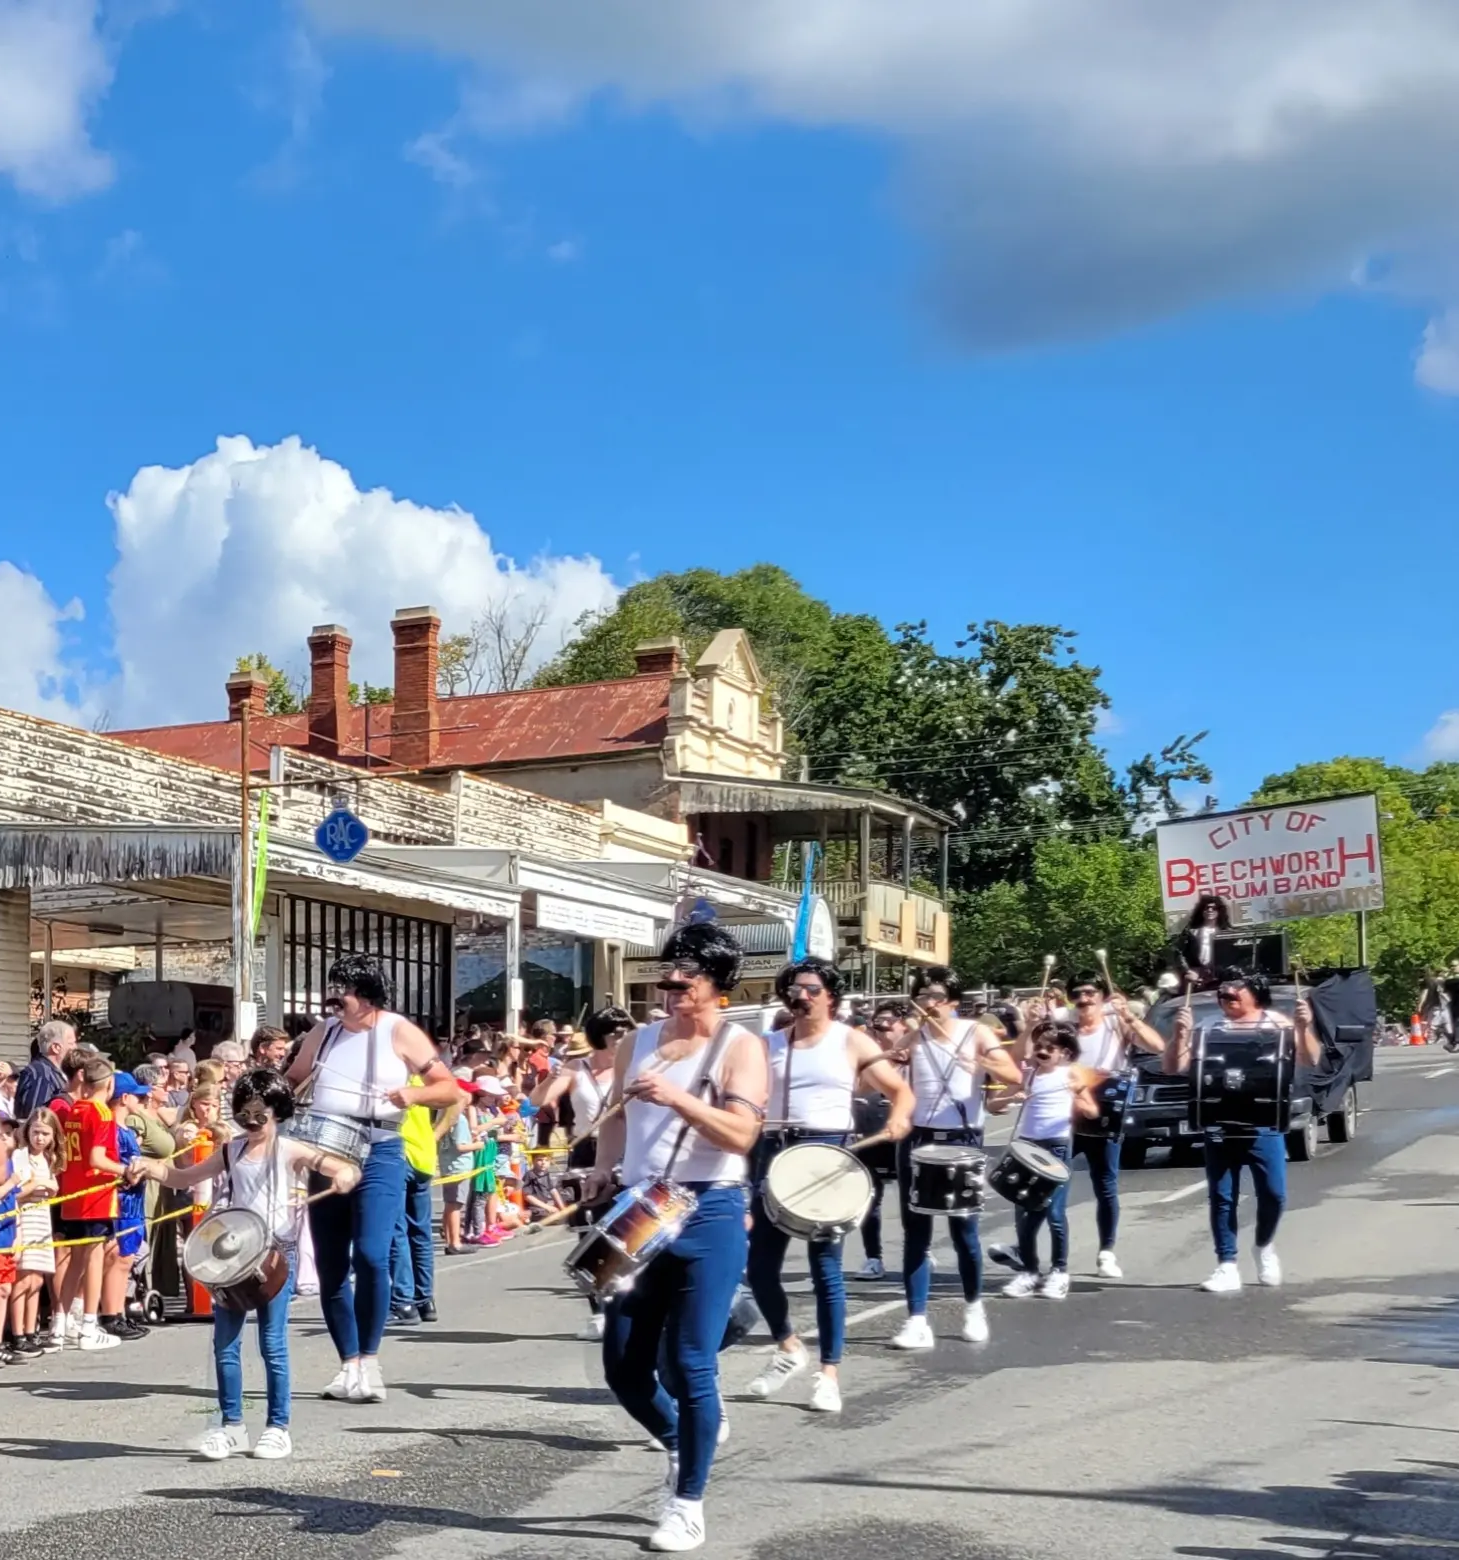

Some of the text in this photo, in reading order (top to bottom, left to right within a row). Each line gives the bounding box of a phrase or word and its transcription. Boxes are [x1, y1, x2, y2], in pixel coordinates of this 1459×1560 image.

[1208, 811, 1326, 850] CITY OF
[1166, 834, 1375, 898] BEECHWORTH
[1274, 871, 1341, 895] BAND
